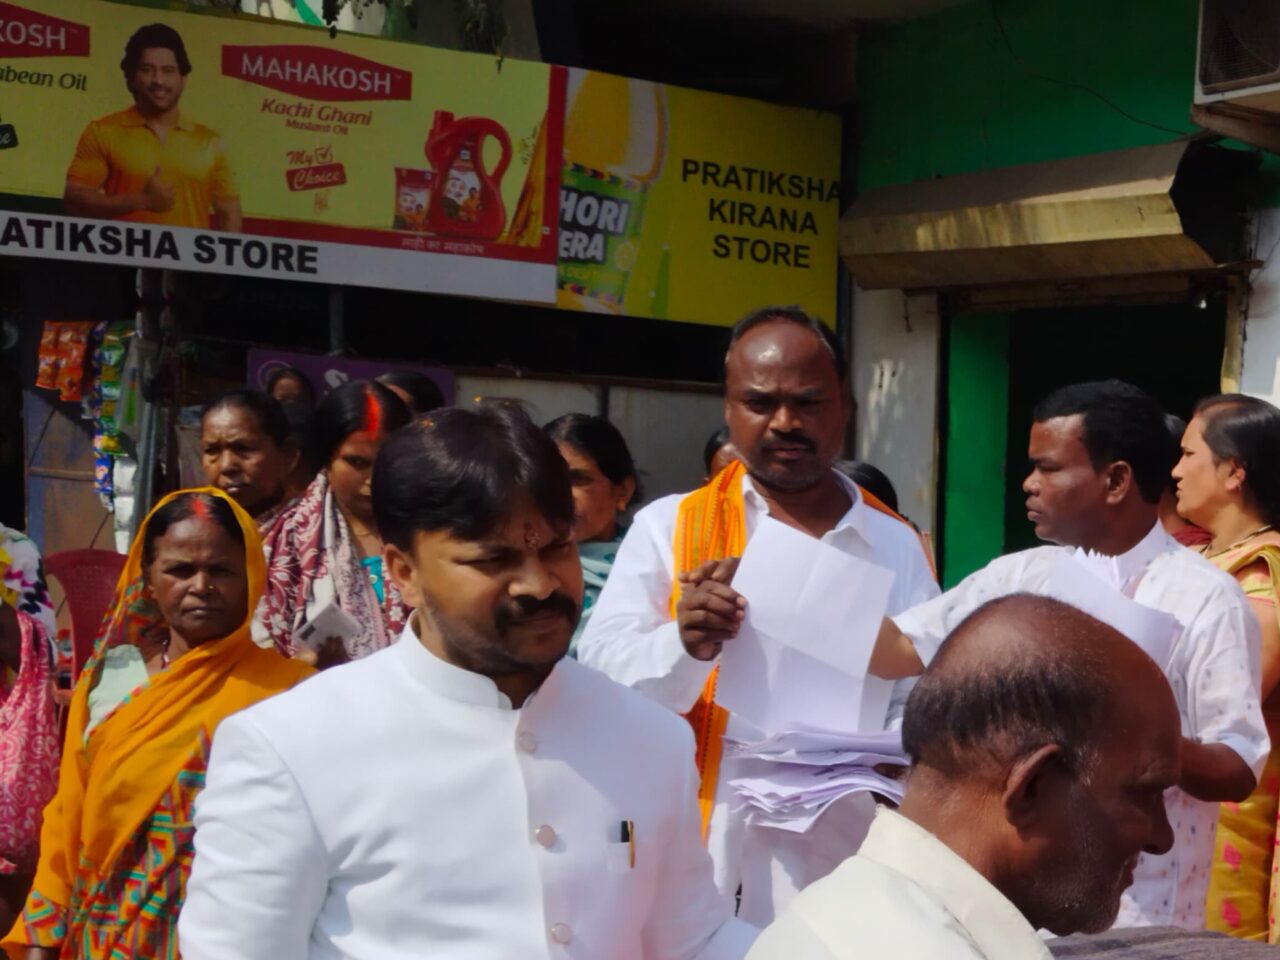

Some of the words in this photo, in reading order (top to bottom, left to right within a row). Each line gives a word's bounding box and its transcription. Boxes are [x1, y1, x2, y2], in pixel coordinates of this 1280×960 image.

[59, 73, 87, 91] Oil
[241, 52, 391, 94] MAHAKOSH
[261, 98, 314, 118] Kachi
[318, 104, 373, 126] Ghani
[293, 168, 340, 189] Choice
[682, 159, 840, 202] PRATIKSHA
[709, 198, 818, 235] KIRANA
[0, 217, 181, 261] ATIKSHA
[193, 234, 319, 274] STORE
[713, 234, 811, 268] STORE
